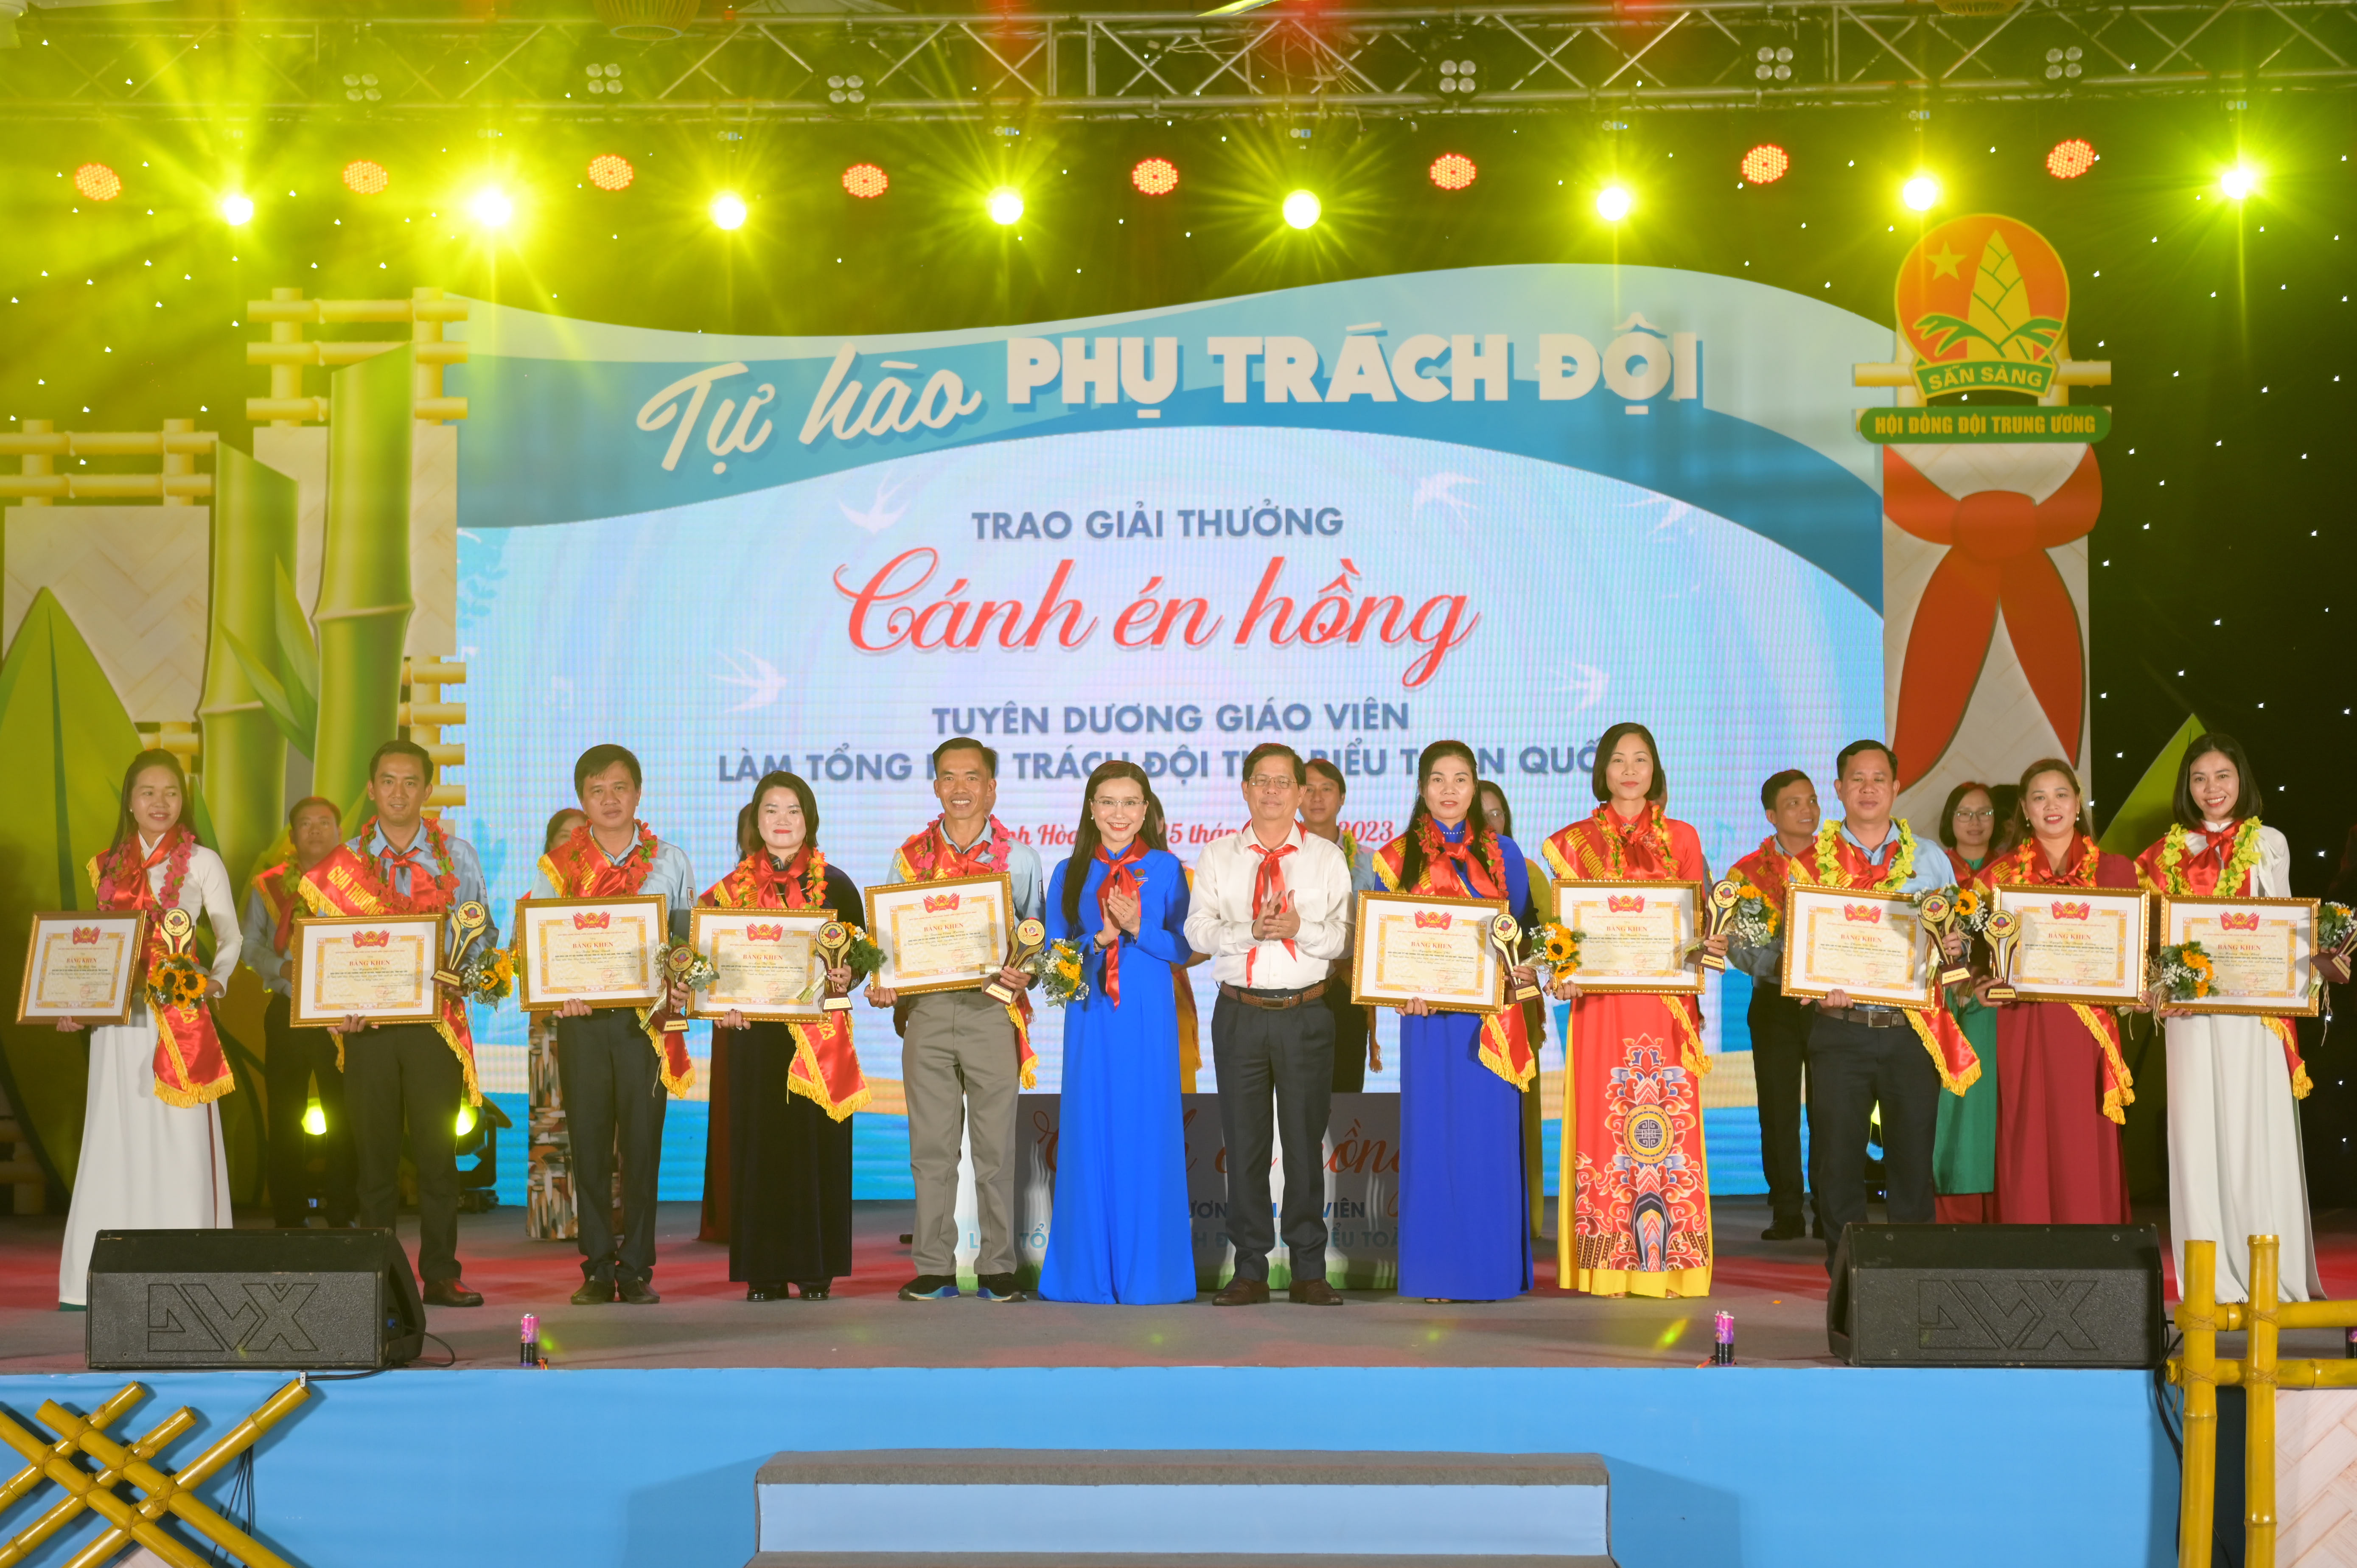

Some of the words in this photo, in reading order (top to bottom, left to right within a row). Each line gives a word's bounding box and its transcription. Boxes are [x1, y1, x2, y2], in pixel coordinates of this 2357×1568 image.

[1007, 337, 1177, 418] PHỤ
[1207, 321, 1508, 403] TRÁCH
[1534, 312, 1697, 414] ĐỘI
[1981, 364, 2042, 388] SÀNG
[1875, 413, 1903, 437] HỘI
[1909, 411, 1953, 434] ĐỒNG
[1958, 413, 1986, 437] ĐỘI
[1992, 416, 2045, 434] TRUNG
[2051, 414, 2096, 433] ƯƠNG
[972, 512, 1072, 540] TRAO
[1085, 501, 1163, 539] GIẢI
[1178, 499, 1344, 537] THƯỞNG
[833, 547, 1098, 651] Cánh
[1113, 576, 1223, 647] én
[1234, 556, 1480, 688] hồng
[932, 700, 1049, 734] TUYÊN
[1064, 703, 1202, 733] DƯƠNG
[1216, 697, 1312, 732] GIÁO
[1324, 696, 1409, 730] VIÊN
[719, 747, 793, 782] LÀM
[806, 742, 912, 781] TỔNG
[1142, 744, 1208, 785] ĐỘI
[1519, 737, 1601, 776] QUỐ
